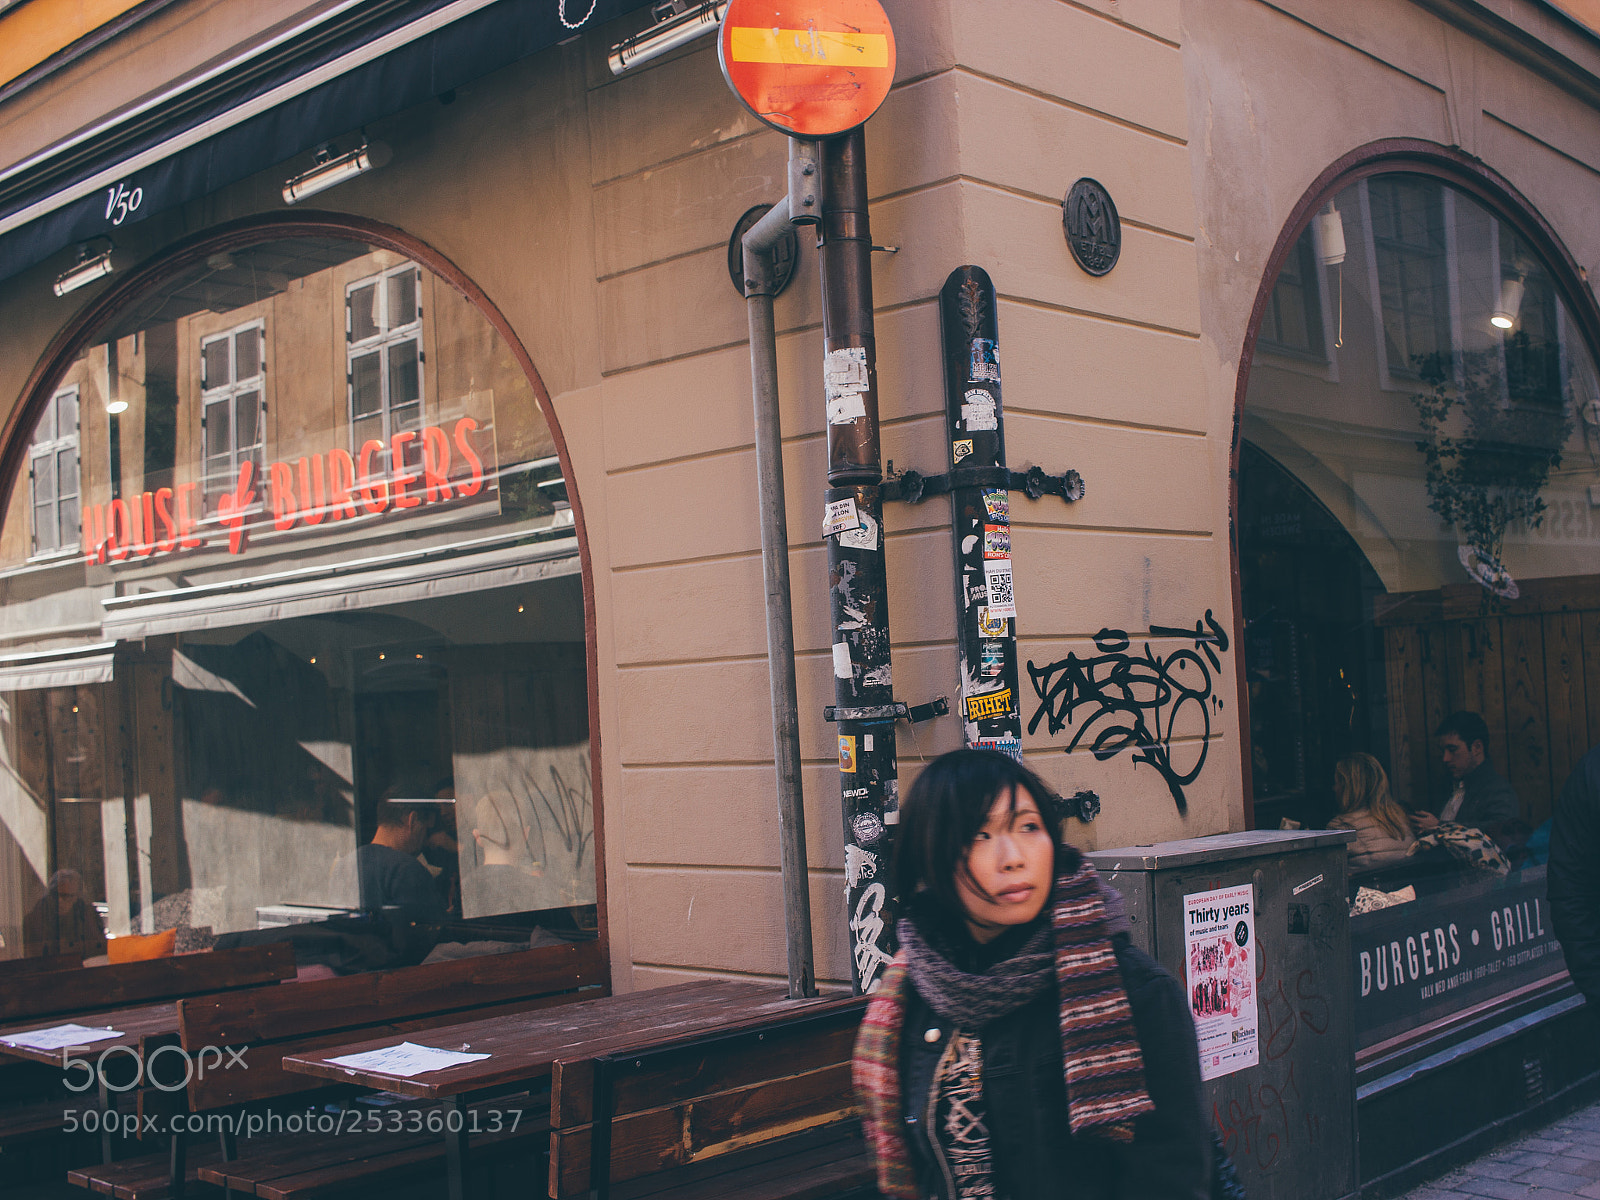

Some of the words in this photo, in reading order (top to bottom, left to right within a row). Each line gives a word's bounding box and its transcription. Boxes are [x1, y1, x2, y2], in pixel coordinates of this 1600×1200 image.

[83, 482, 200, 566] HOUSE
[218, 461, 260, 555] of
[271, 418, 488, 532] BURGERS
[1188, 897, 1209, 905] EUROPEAN
[1188, 907, 1220, 924] Thirty
[1222, 902, 1249, 921] years
[1189, 928, 1195, 937] of
[1195, 927, 1209, 936] music
[1360, 923, 1461, 997] BURGERS
[1491, 898, 1545, 951] GRILL
